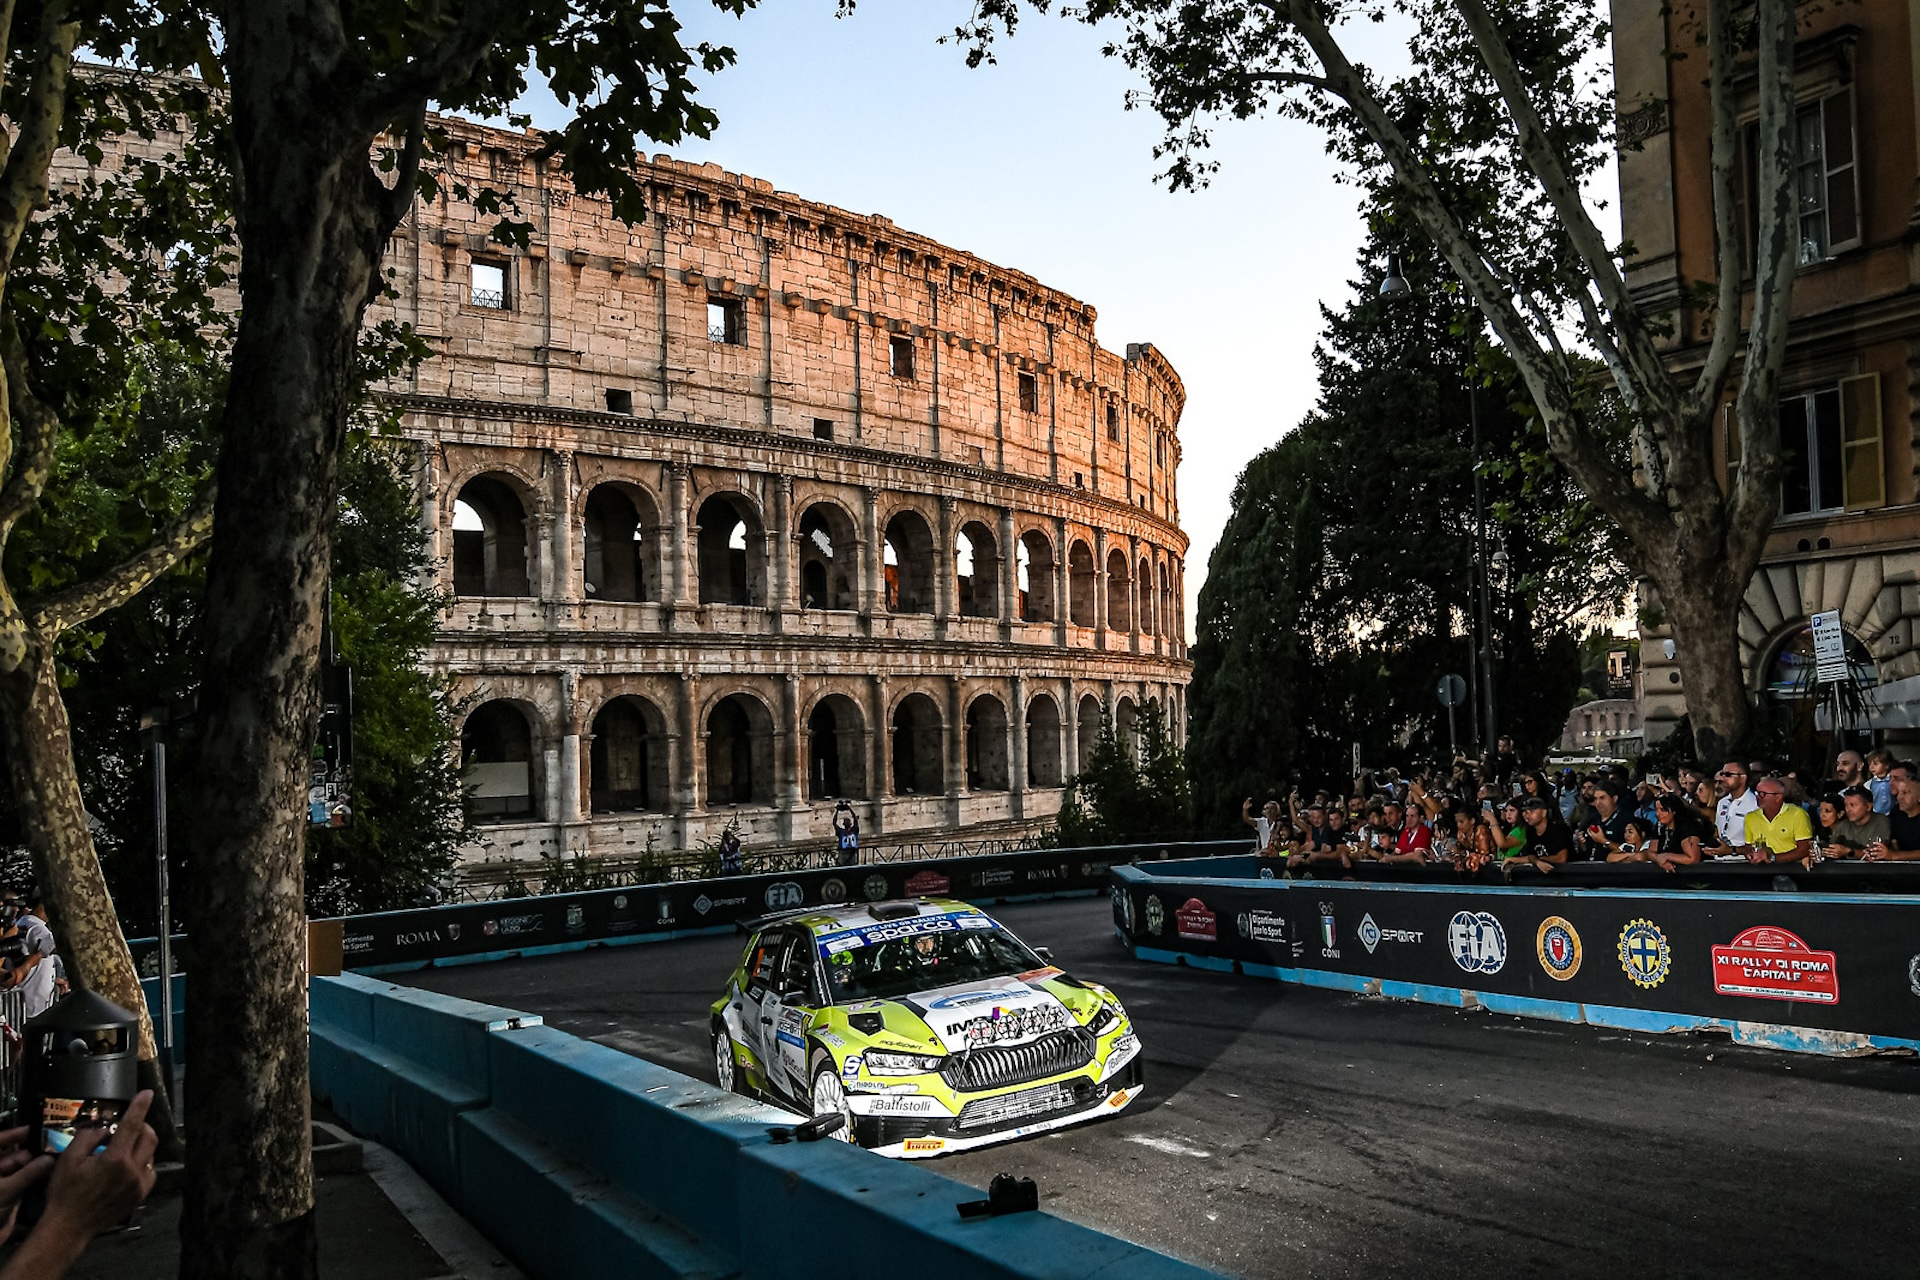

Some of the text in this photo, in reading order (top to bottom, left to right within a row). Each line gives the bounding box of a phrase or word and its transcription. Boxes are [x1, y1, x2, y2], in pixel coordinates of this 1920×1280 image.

[1814, 618, 1821, 627] P
[1609, 651, 1627, 677] T
[1028, 869, 1056, 880] ROMA
[880, 920, 898, 931] LIVE
[1252, 914, 1285, 927] Dipartimento
[867, 920, 953, 942] sparco
[1381, 928, 1425, 944] SPORT
[396, 930, 440, 946] ROMA
[1321, 948, 1341, 959] CONI
[1717, 956, 1830, 972] XI RALLY DI ROMA
[1742, 967, 1802, 981] CAPITALE
[876, 1099, 931, 1112] Battistolli
[907, 1141, 942, 1150] PIRELLI
